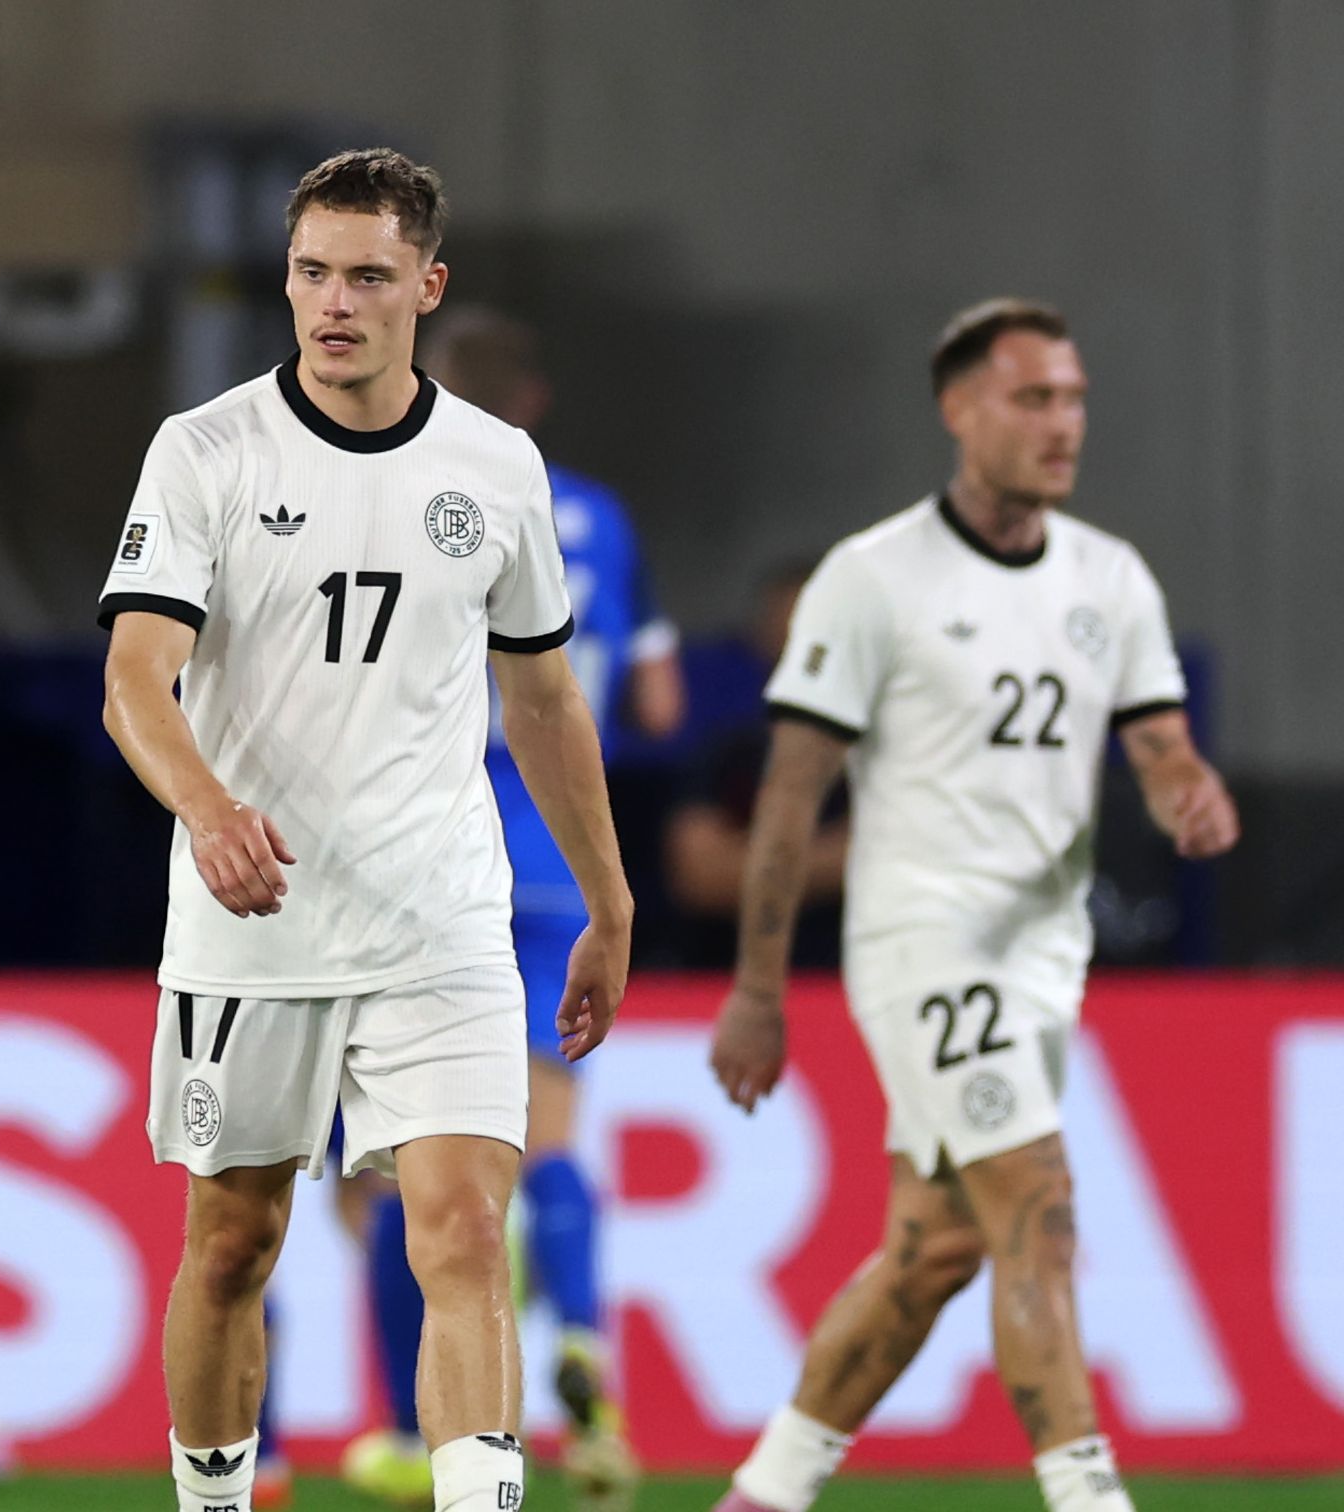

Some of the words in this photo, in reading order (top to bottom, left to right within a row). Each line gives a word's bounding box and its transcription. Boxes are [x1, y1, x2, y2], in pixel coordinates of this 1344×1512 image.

[317, 570, 402, 664] 17
[988, 669, 1066, 747] 22
[920, 982, 1014, 1071] 22
